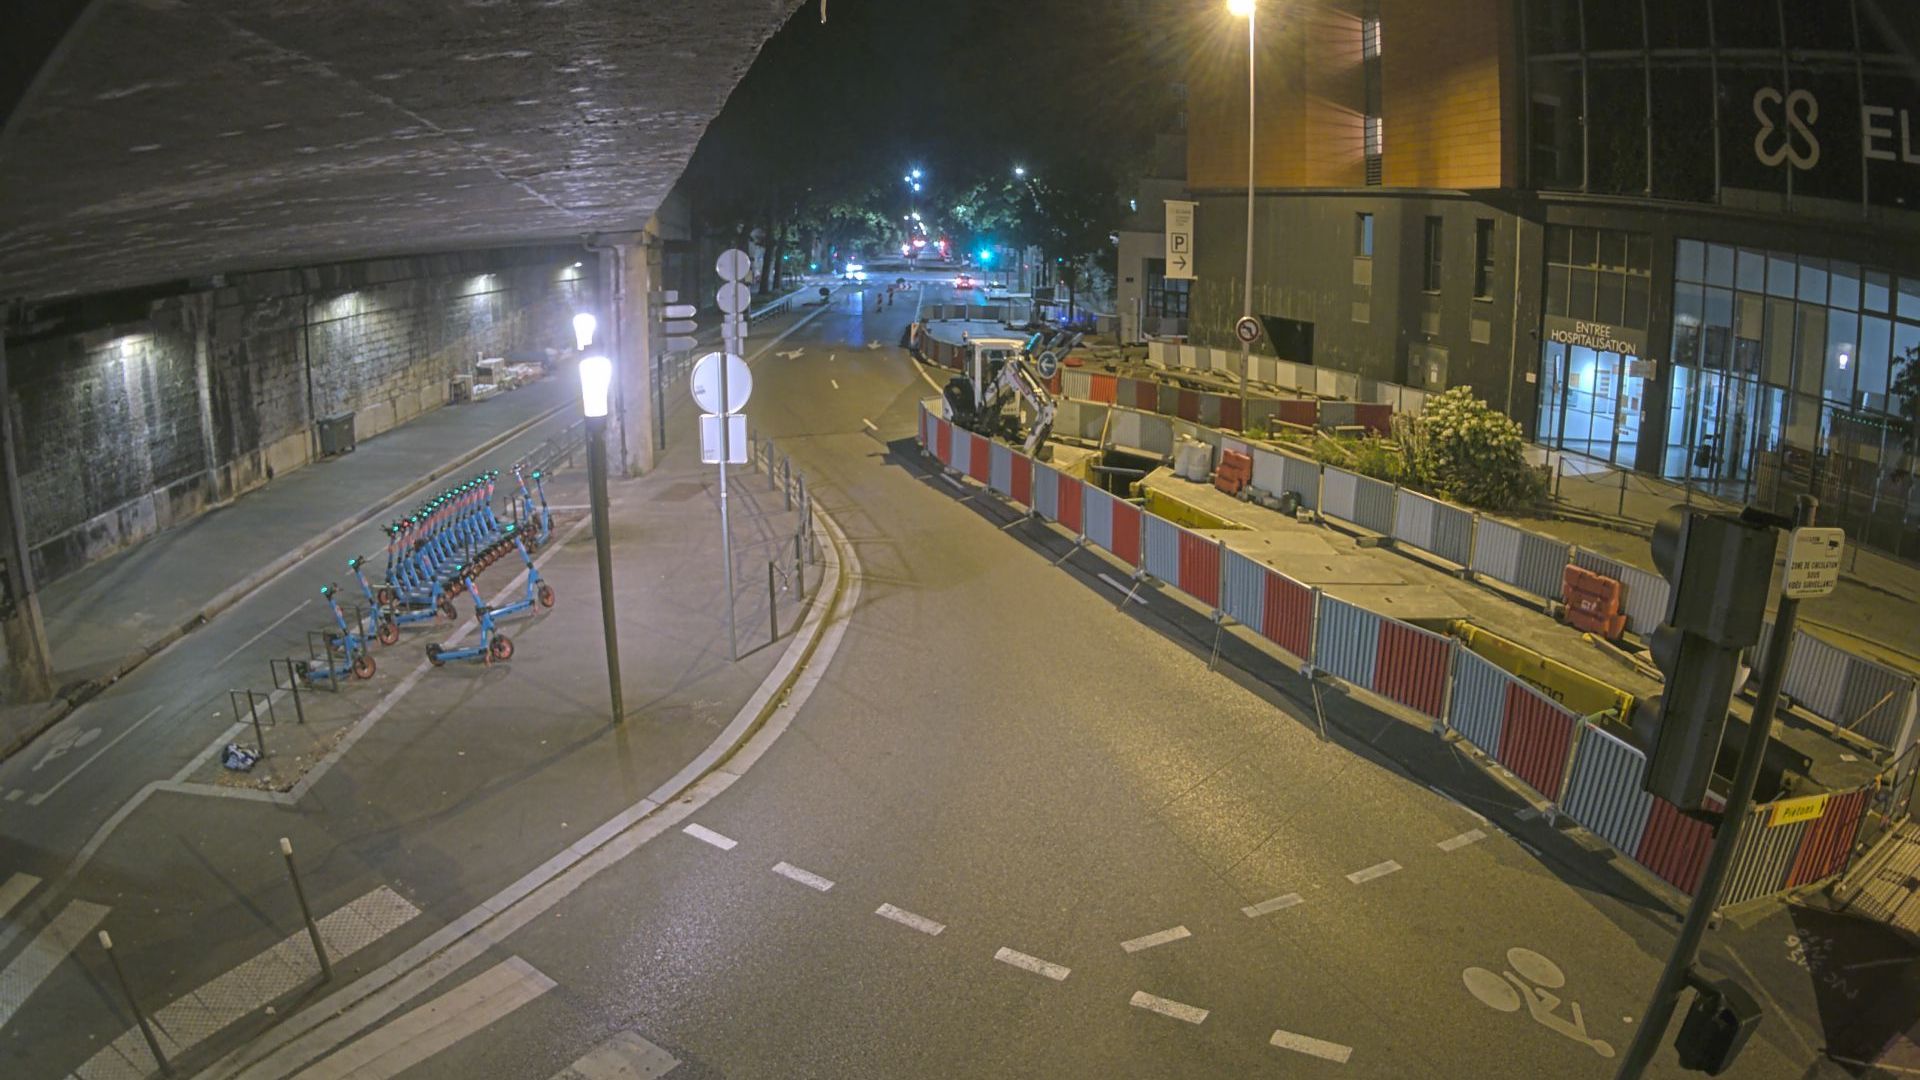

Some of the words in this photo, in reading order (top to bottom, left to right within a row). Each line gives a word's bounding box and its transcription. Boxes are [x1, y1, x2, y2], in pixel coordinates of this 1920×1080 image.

[1862, 105, 1920, 164] EL
[1175, 236, 1184, 250] P
[1551, 328, 1637, 354] HOSPITALISATION
[1811, 561, 1838, 569] CIRCULATION
